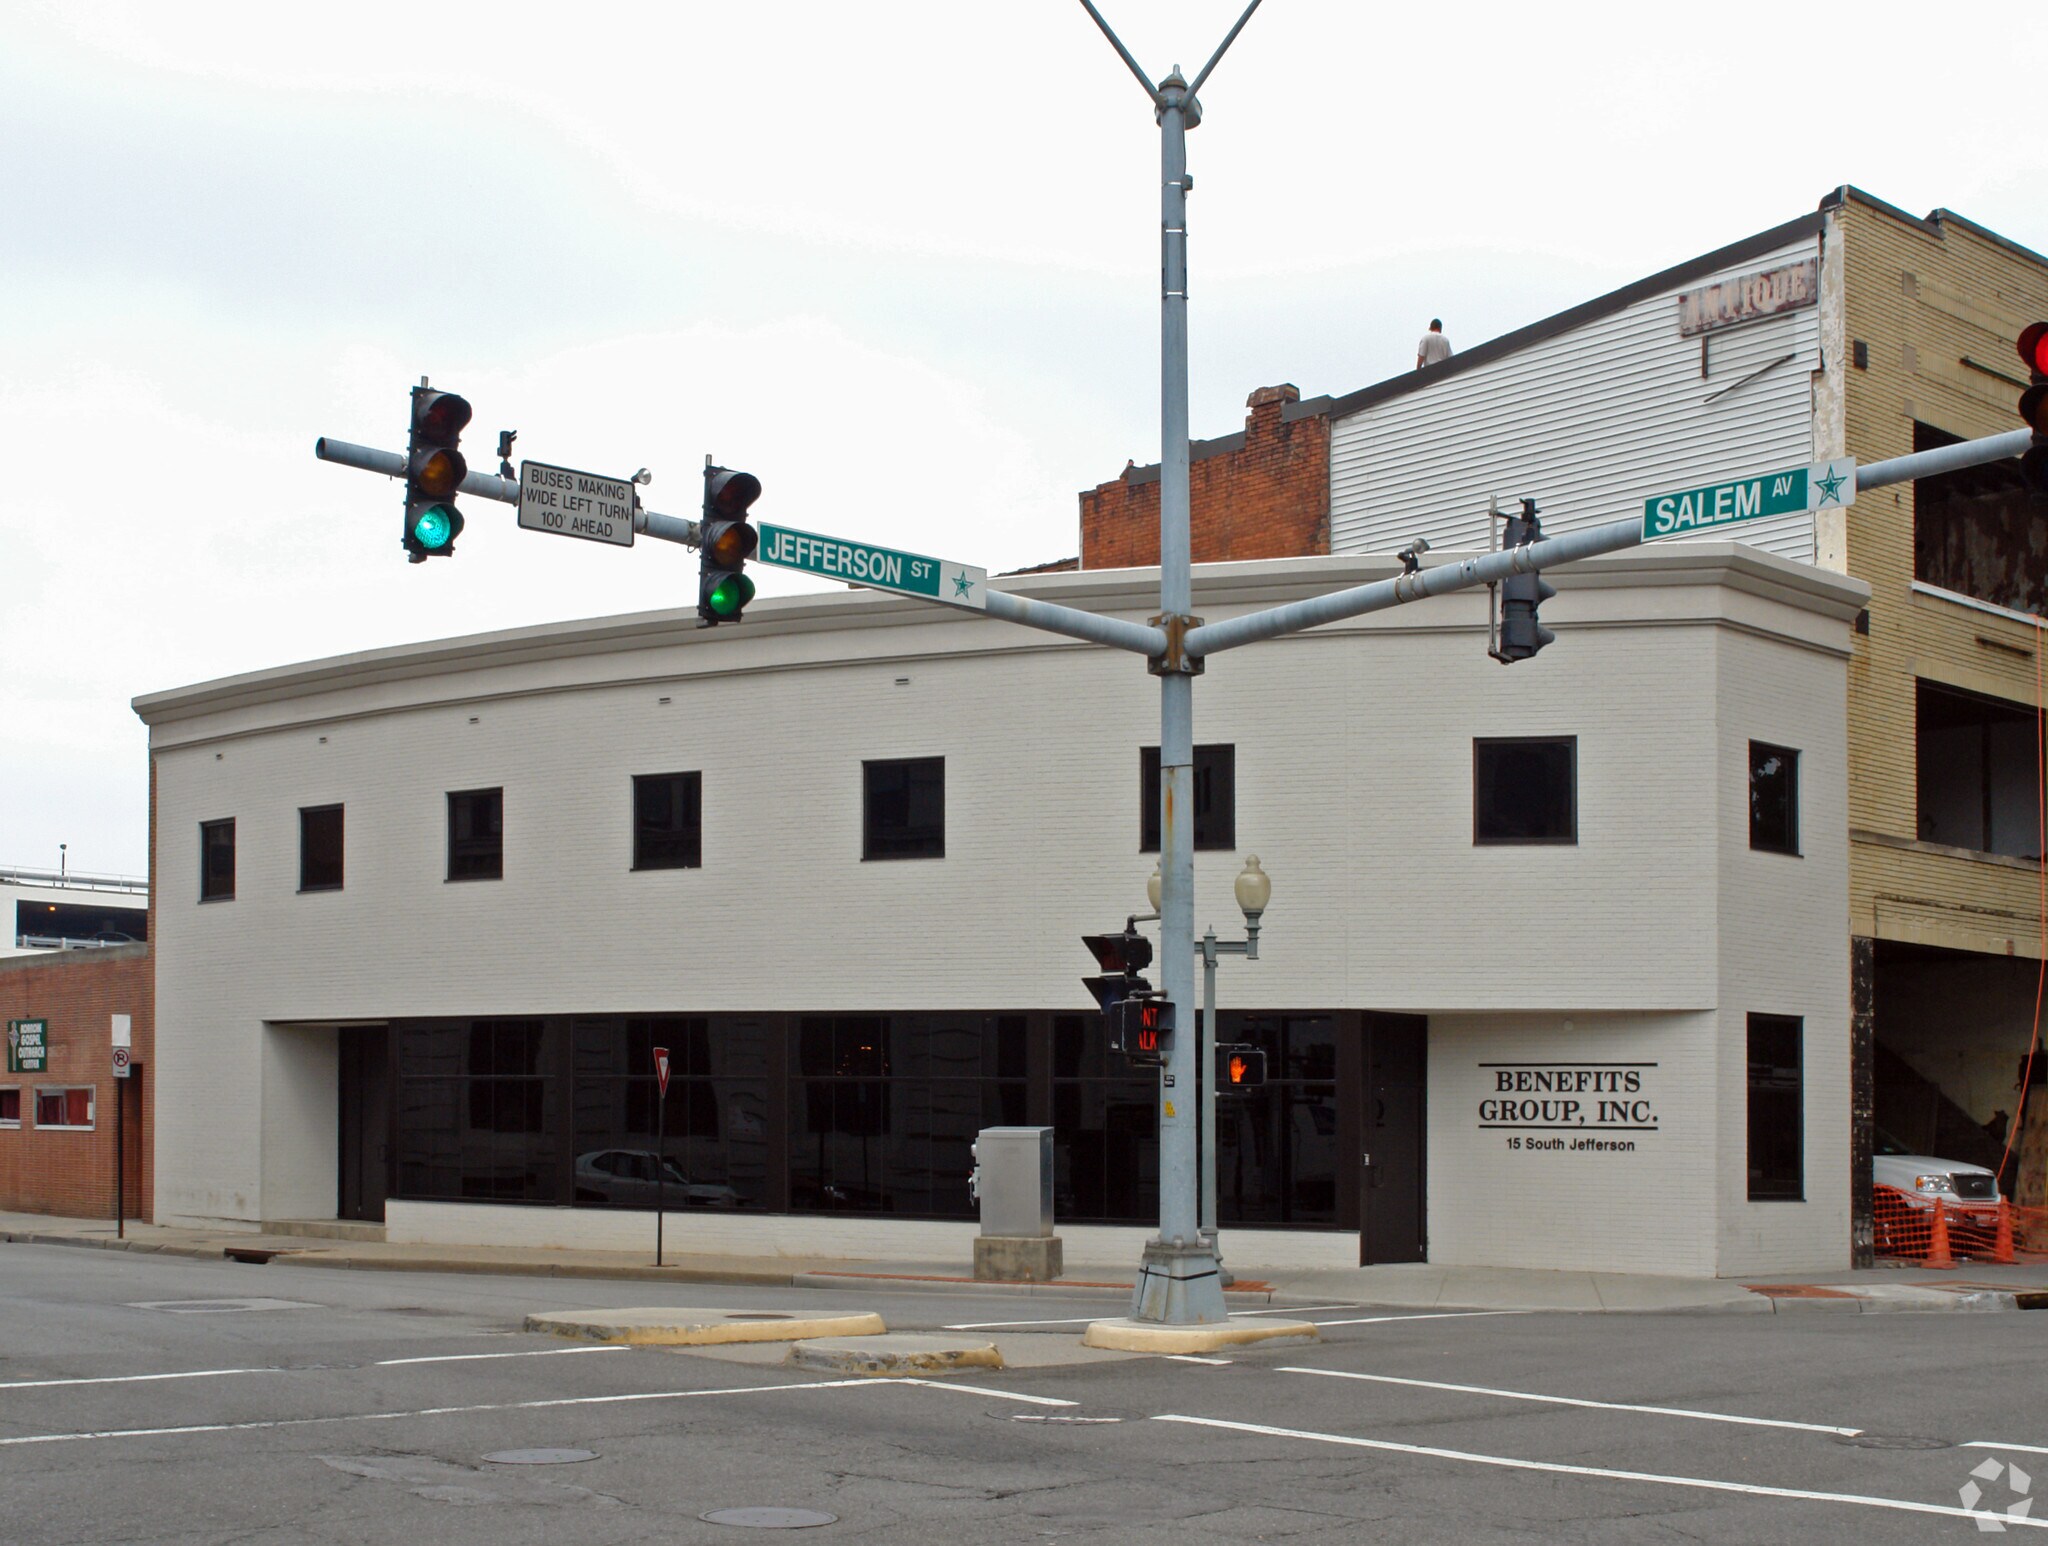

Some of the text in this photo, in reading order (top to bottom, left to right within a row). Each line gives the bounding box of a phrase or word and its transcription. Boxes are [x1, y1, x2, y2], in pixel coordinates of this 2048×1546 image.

[531, 469, 625, 500] BUSES MAKING
[526, 488, 629, 520] WIDE LEFT TURN
[1655, 475, 1793, 532] SALEM AV
[541, 512, 613, 537] 100' AHEAD
[767, 532, 932, 584] JEFFERSON ST
[1495, 1071, 1640, 1092] BENEFITS
[1479, 1099, 1658, 1125] GROUP, INC.
[1506, 1137, 1635, 1151] 15 South Jefferson
